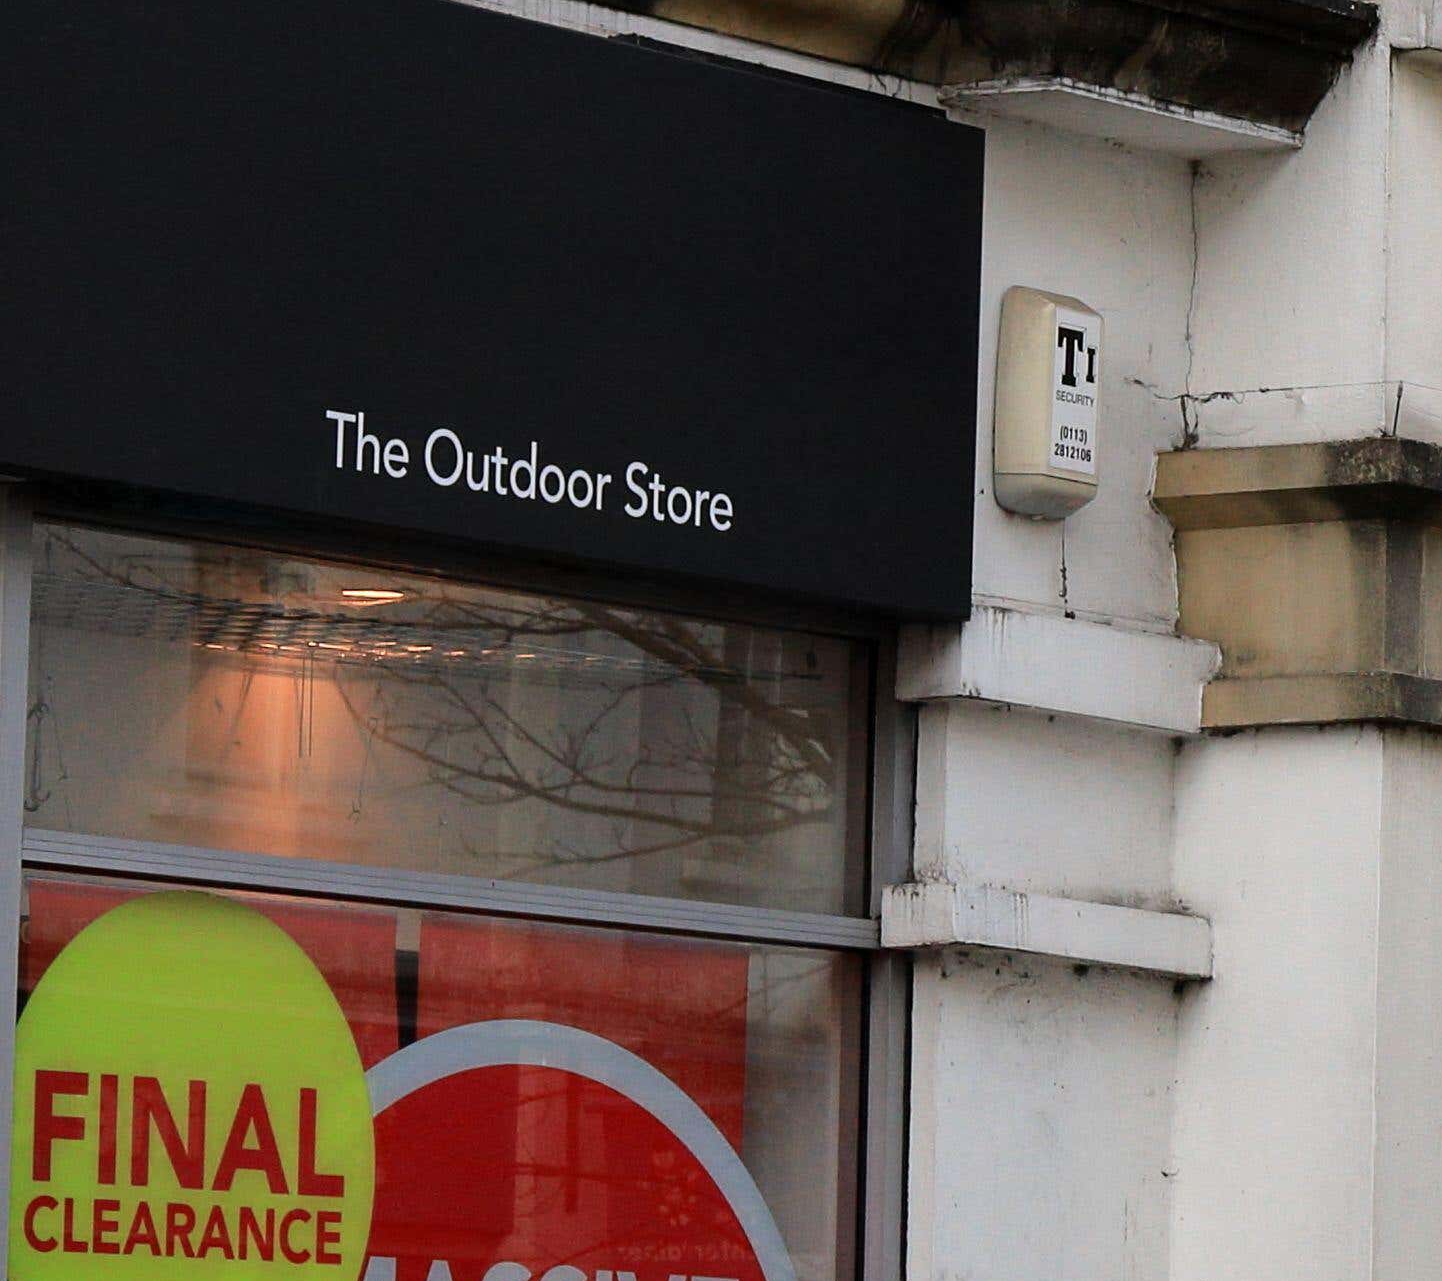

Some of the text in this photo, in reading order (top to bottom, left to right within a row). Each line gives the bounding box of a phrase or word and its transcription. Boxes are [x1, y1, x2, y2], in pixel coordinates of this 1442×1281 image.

[1056, 389, 1095, 408] SECURITY
[1054, 443, 1092, 462] 2812106
[1059, 425, 1088, 443] (0113)
[326, 409, 734, 532] The Outdoor Store
[31, 1068, 345, 1199] FINAL
[23, 1194, 343, 1266] CLEARANCE
